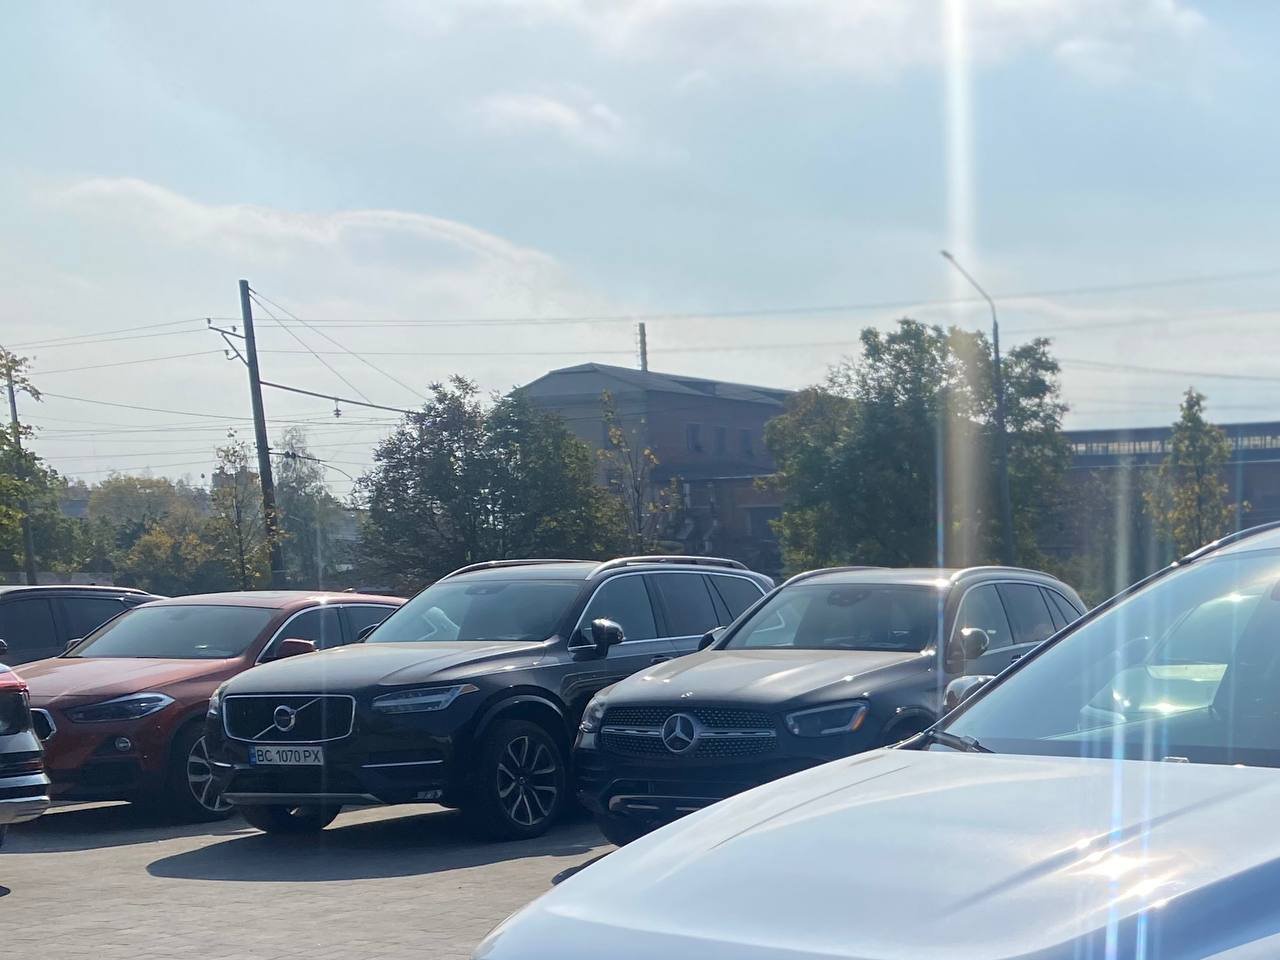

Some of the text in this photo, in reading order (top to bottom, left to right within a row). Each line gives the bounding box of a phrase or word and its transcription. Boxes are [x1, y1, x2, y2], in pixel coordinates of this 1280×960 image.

[257, 750, 321, 763] BC 1070 PX
